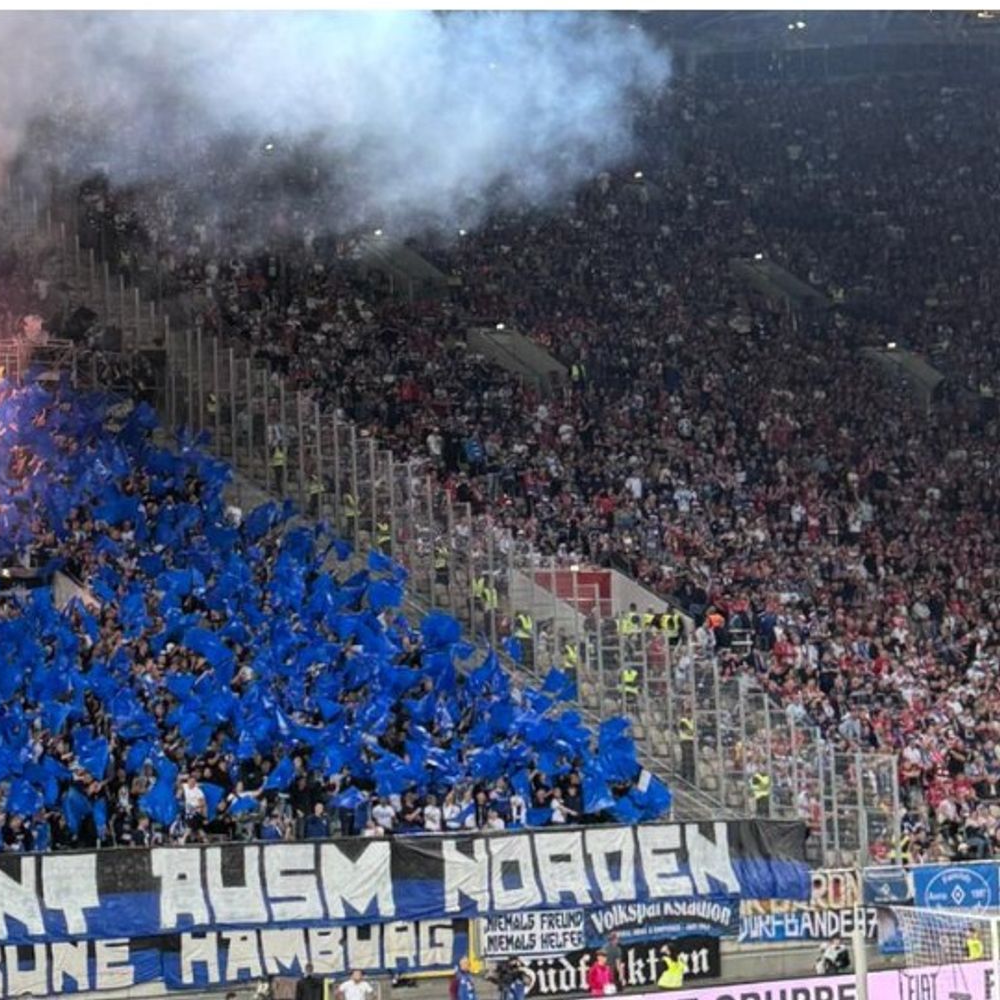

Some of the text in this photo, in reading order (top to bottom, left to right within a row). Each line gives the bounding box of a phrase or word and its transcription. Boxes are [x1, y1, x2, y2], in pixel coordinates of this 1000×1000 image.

[152, 841, 396, 929] AUSM
[442, 822, 740, 913] NORDEN
[181, 921, 454, 983] HAMBURG
